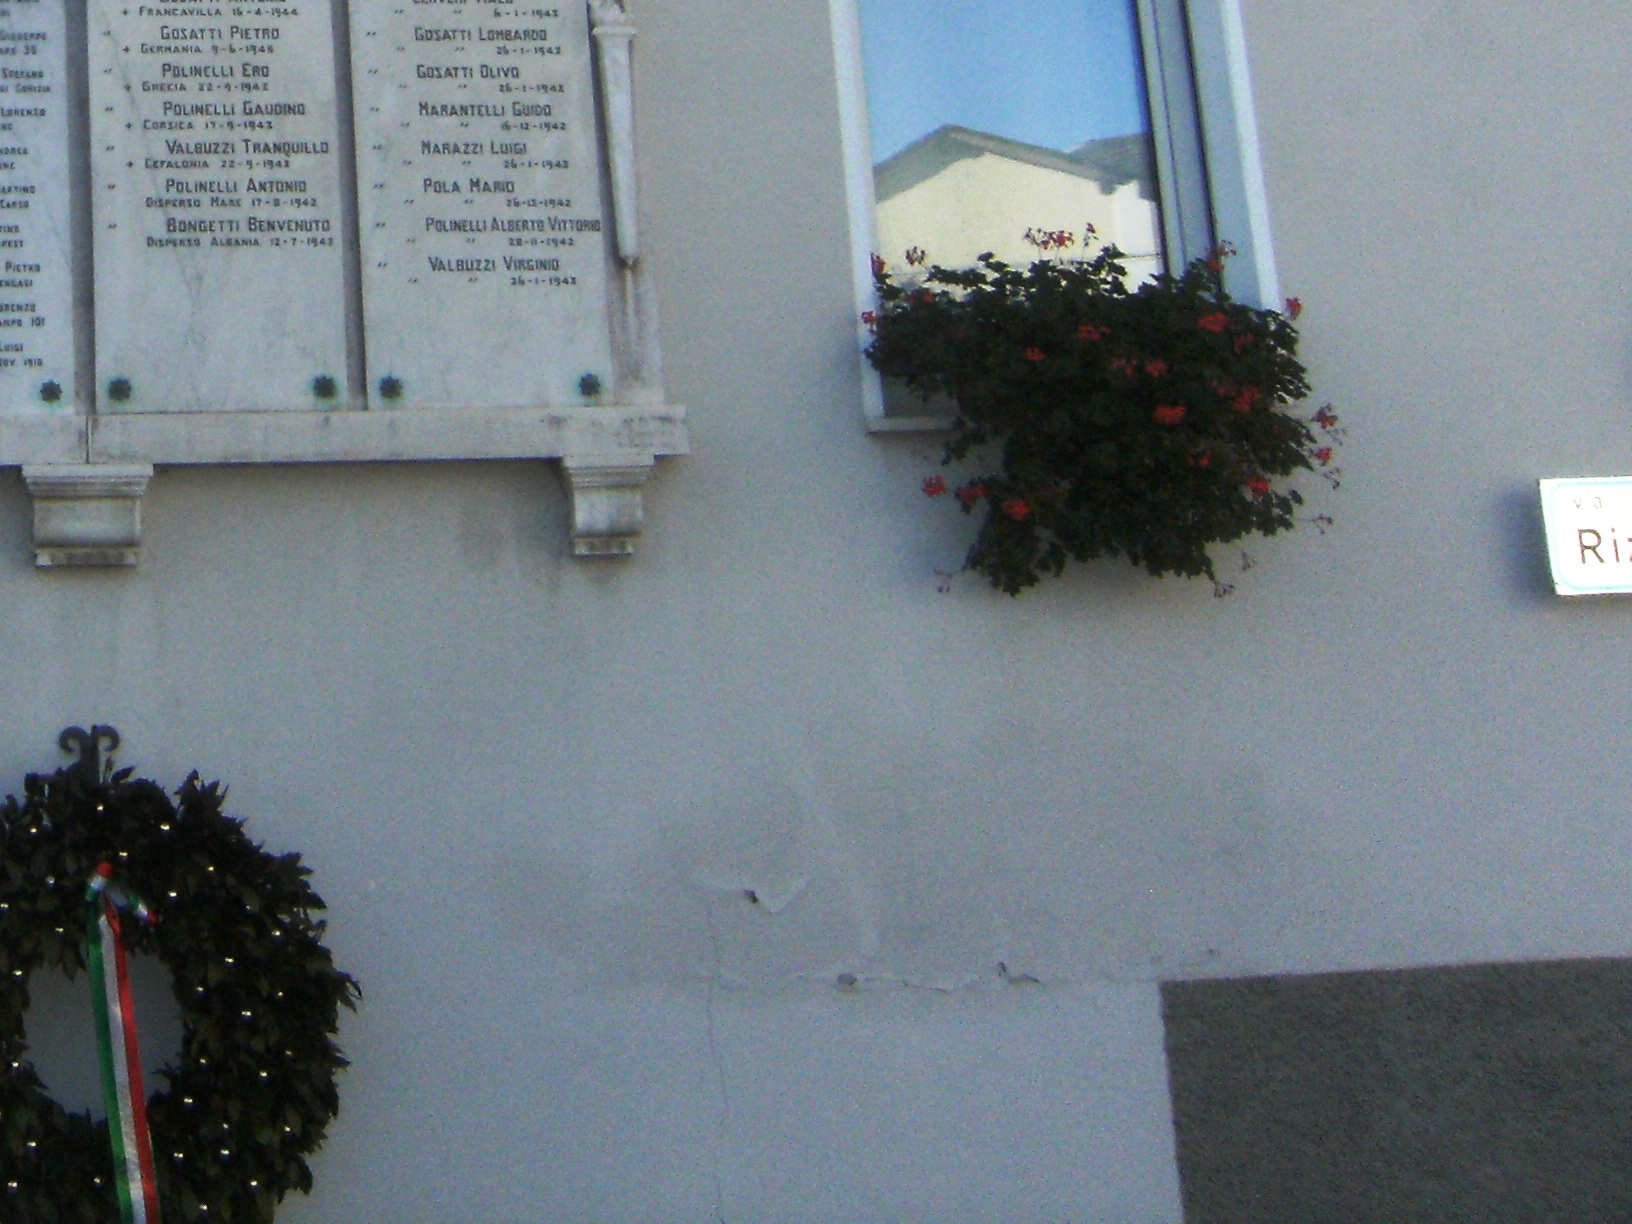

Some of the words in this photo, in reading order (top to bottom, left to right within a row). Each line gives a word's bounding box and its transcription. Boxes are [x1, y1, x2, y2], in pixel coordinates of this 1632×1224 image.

[230, 25, 279, 39] PIETRO
[479, 29, 547, 41] LOMBARDO
[163, 101, 235, 116] POLINELLI
[419, 103, 504, 116] MARANTELLI
[512, 101, 552, 117] GUIDO
[422, 141, 483, 154] MARAZZI
[490, 142, 527, 155] LUIGI
[166, 179, 237, 193] POLINELLI
[247, 179, 306, 192] ANTONIO
[424, 178, 460, 193] POLA
[470, 178, 514, 193] MARIO
[248, 217, 330, 232] BENVENUTO
[426, 217, 487, 232] POLINELLI
